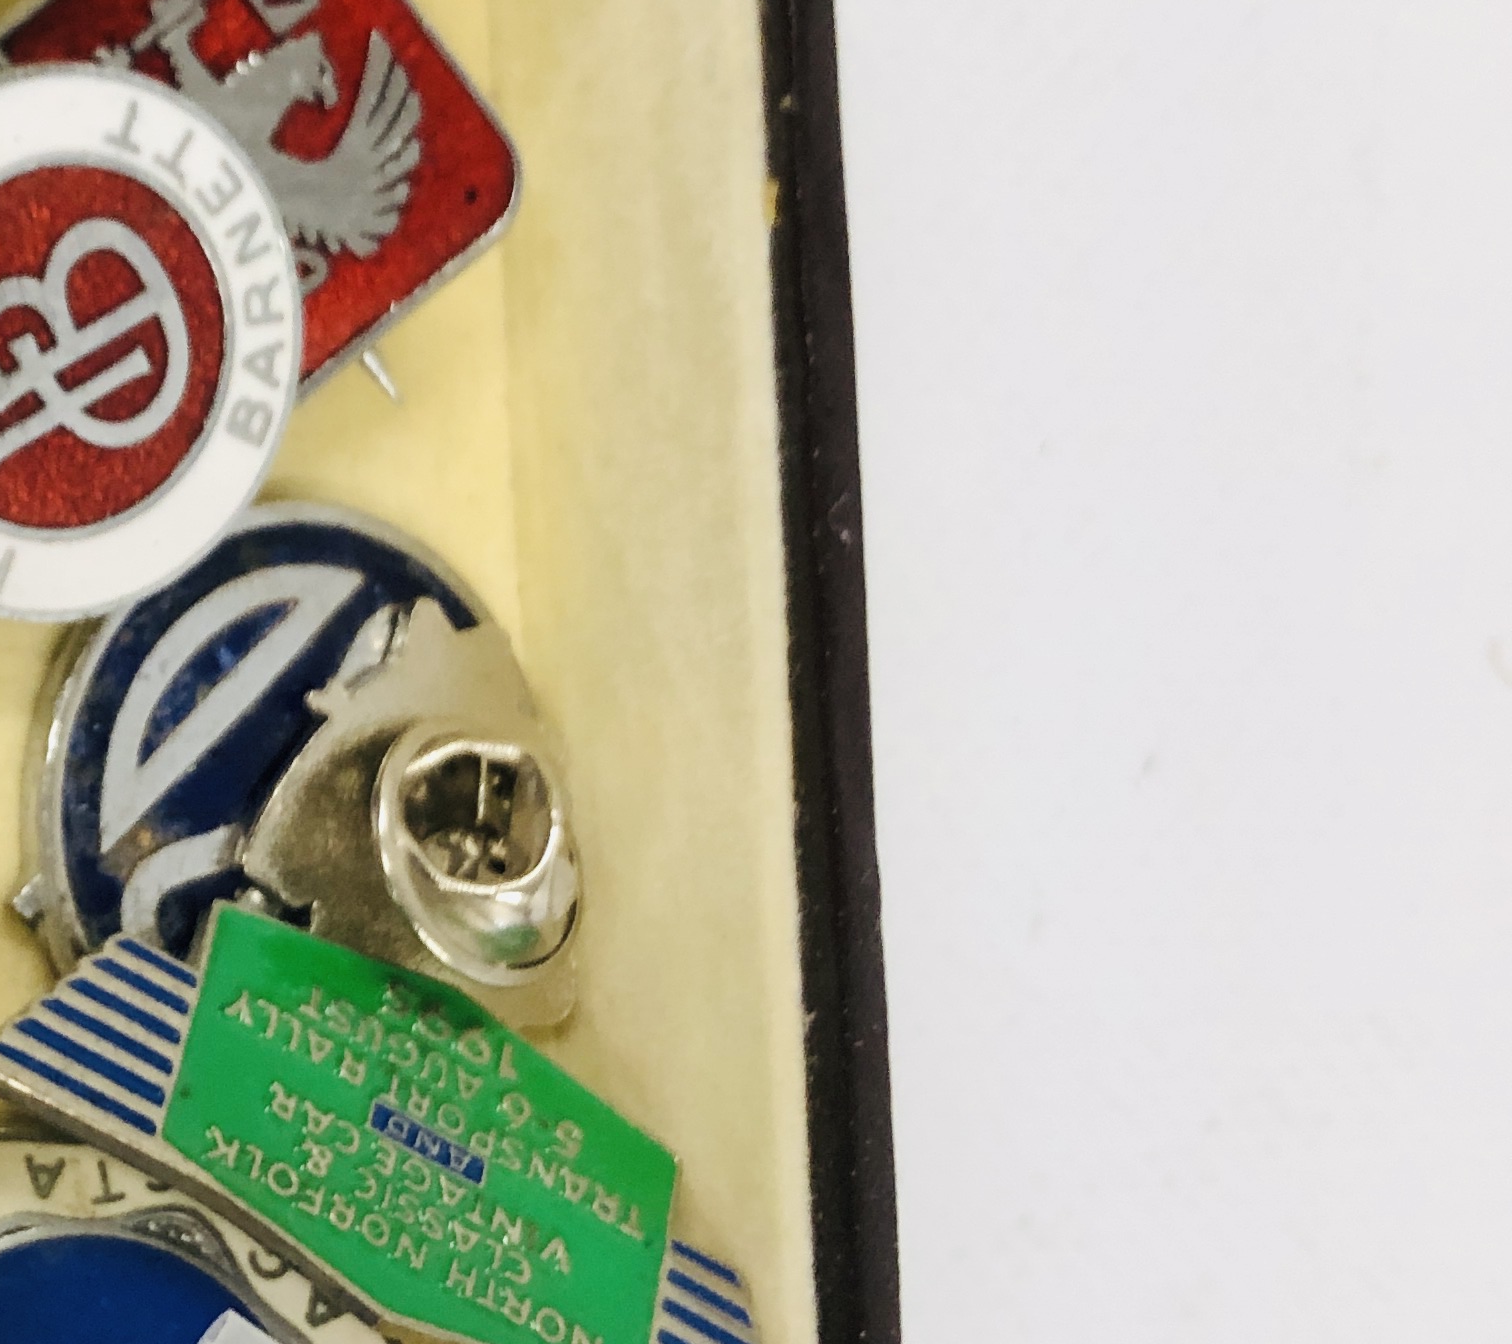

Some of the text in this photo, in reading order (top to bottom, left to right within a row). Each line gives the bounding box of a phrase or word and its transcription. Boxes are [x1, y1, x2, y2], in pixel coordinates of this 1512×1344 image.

[101, 100, 285, 449] BARNETT
[223, 989, 646, 1242] TRANSPORT RALLY
[298, 985, 484, 1100] AUGUST
[204, 1125, 430, 1270] NORFOLK
[266, 1081, 571, 1275] VINTAGE CAR
[298, 1138, 534, 1286] CLASSIC &
[387, 1115, 472, 1174] AND
